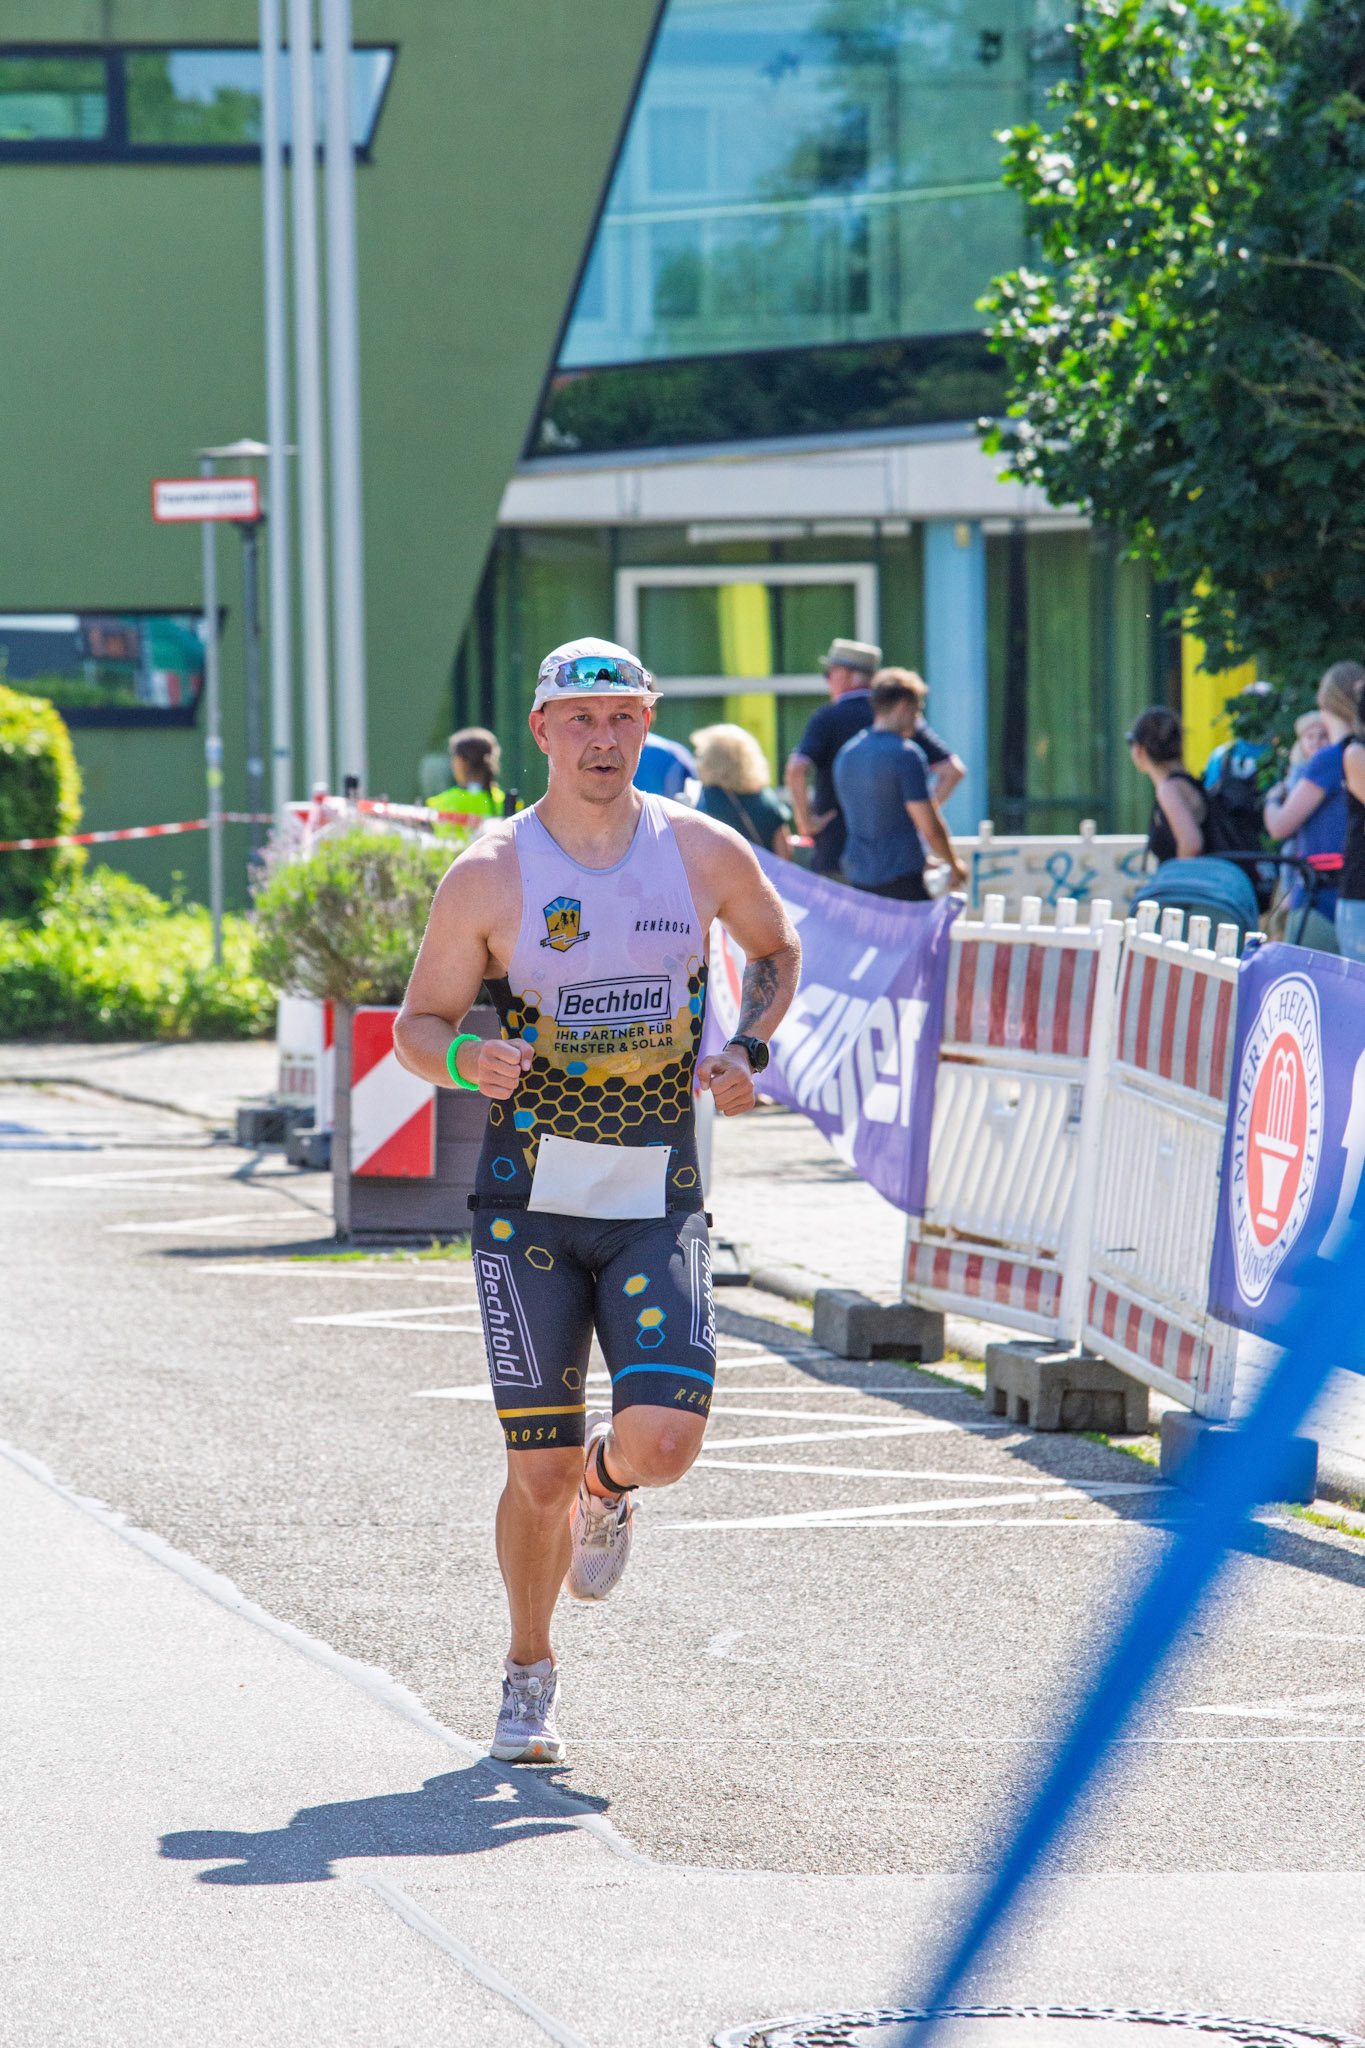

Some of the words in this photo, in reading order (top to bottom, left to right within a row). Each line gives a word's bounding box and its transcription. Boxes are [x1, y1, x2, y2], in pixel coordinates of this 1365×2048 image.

[971, 848, 1019, 909] F
[635, 917, 691, 935] RENÉROSA
[563, 986, 663, 1016] Bechtold
[556, 1030, 579, 1041] IHR
[582, 1026, 644, 1041] PARTNER
[649, 1022, 673, 1035] FÜR
[554, 1042, 616, 1054] FENSTER
[619, 1042, 628, 1052] &
[631, 1036, 673, 1050] SOLAR
[480, 1259, 525, 1378] Bechtold
